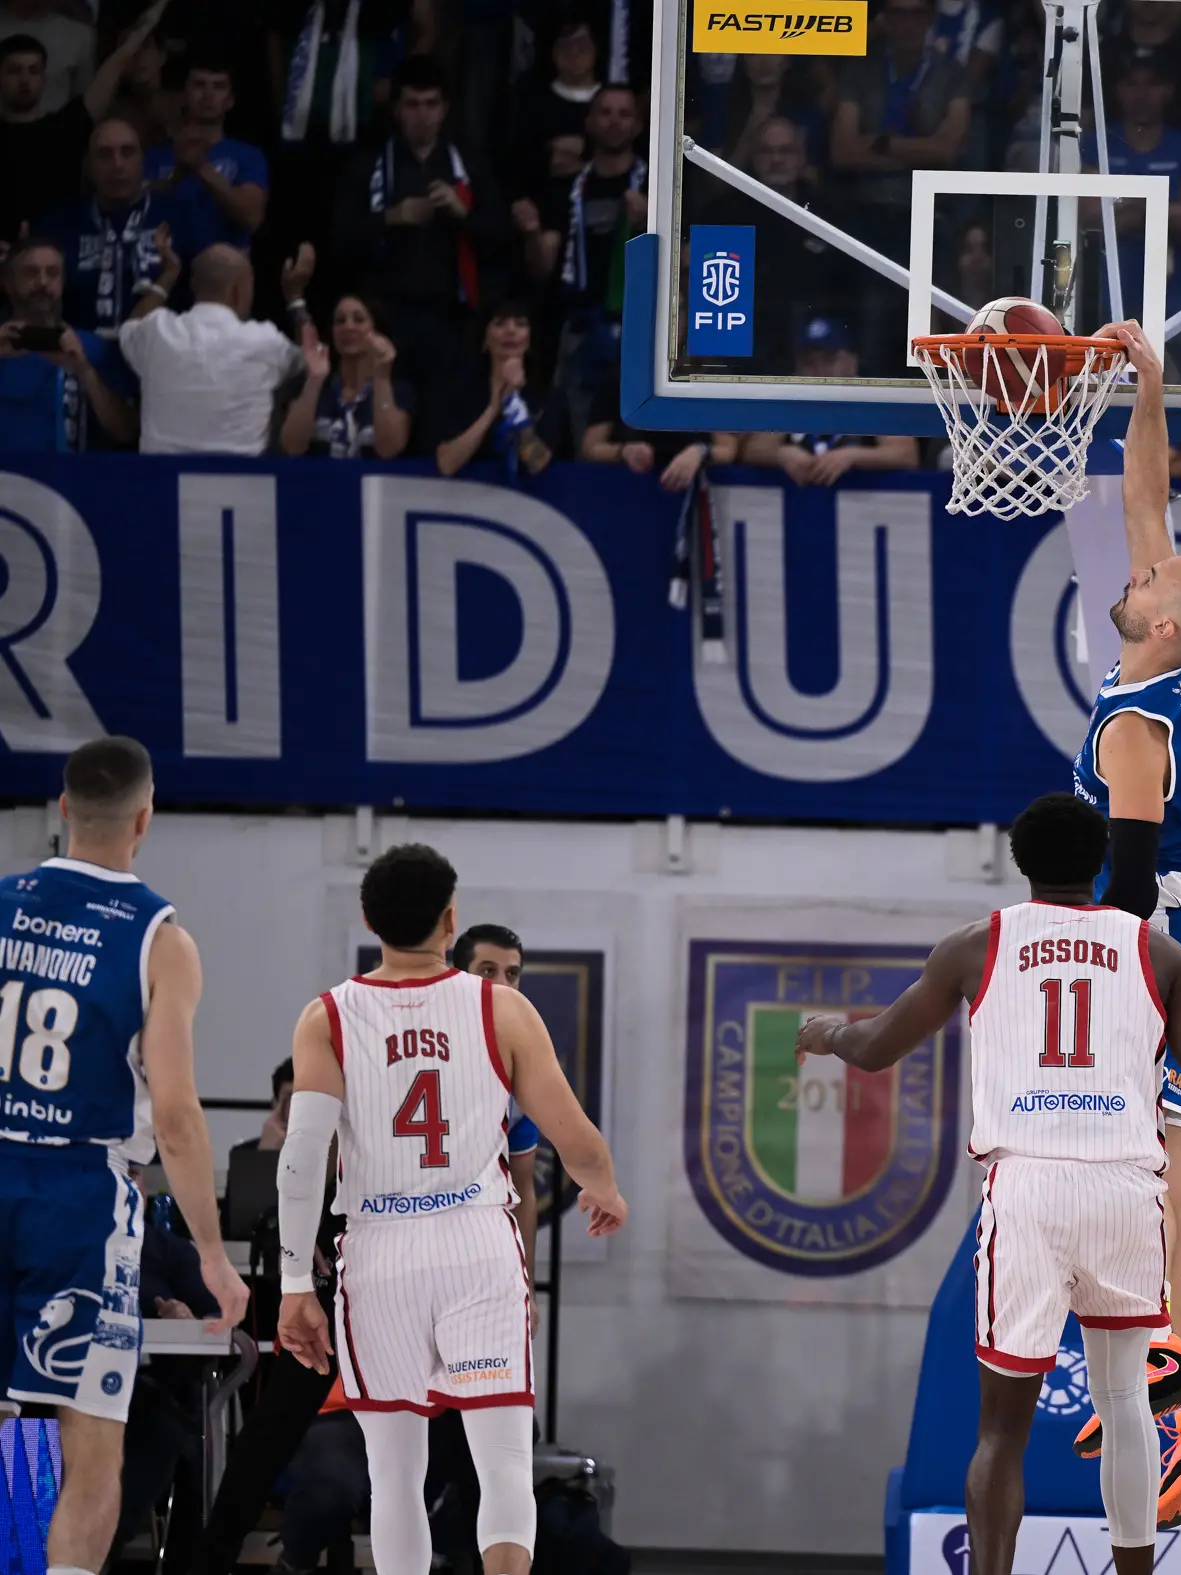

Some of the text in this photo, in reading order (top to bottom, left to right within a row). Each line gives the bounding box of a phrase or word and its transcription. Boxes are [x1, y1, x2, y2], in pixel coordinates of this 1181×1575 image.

[707, 13, 853, 39] FASTWEB
[695, 312, 746, 330] FIP
[1019, 938, 1118, 973] SISSOKO
[0, 980, 78, 1092] 18
[1039, 978, 1095, 1068] 11
[386, 1028, 450, 1067] ROSS
[4, 1093, 73, 1124] inblu
[715, 1020, 751, 1204] CAMPIONE
[776, 1077, 862, 1114] 2011
[1011, 1094, 1126, 1112] AUTOTORINO
[393, 1069, 450, 1169] 4
[360, 1183, 481, 1214] AUTOTORINO
[447, 1357, 509, 1374] BLUENERGY
[450, 1368, 513, 1386] SSISTANCE
